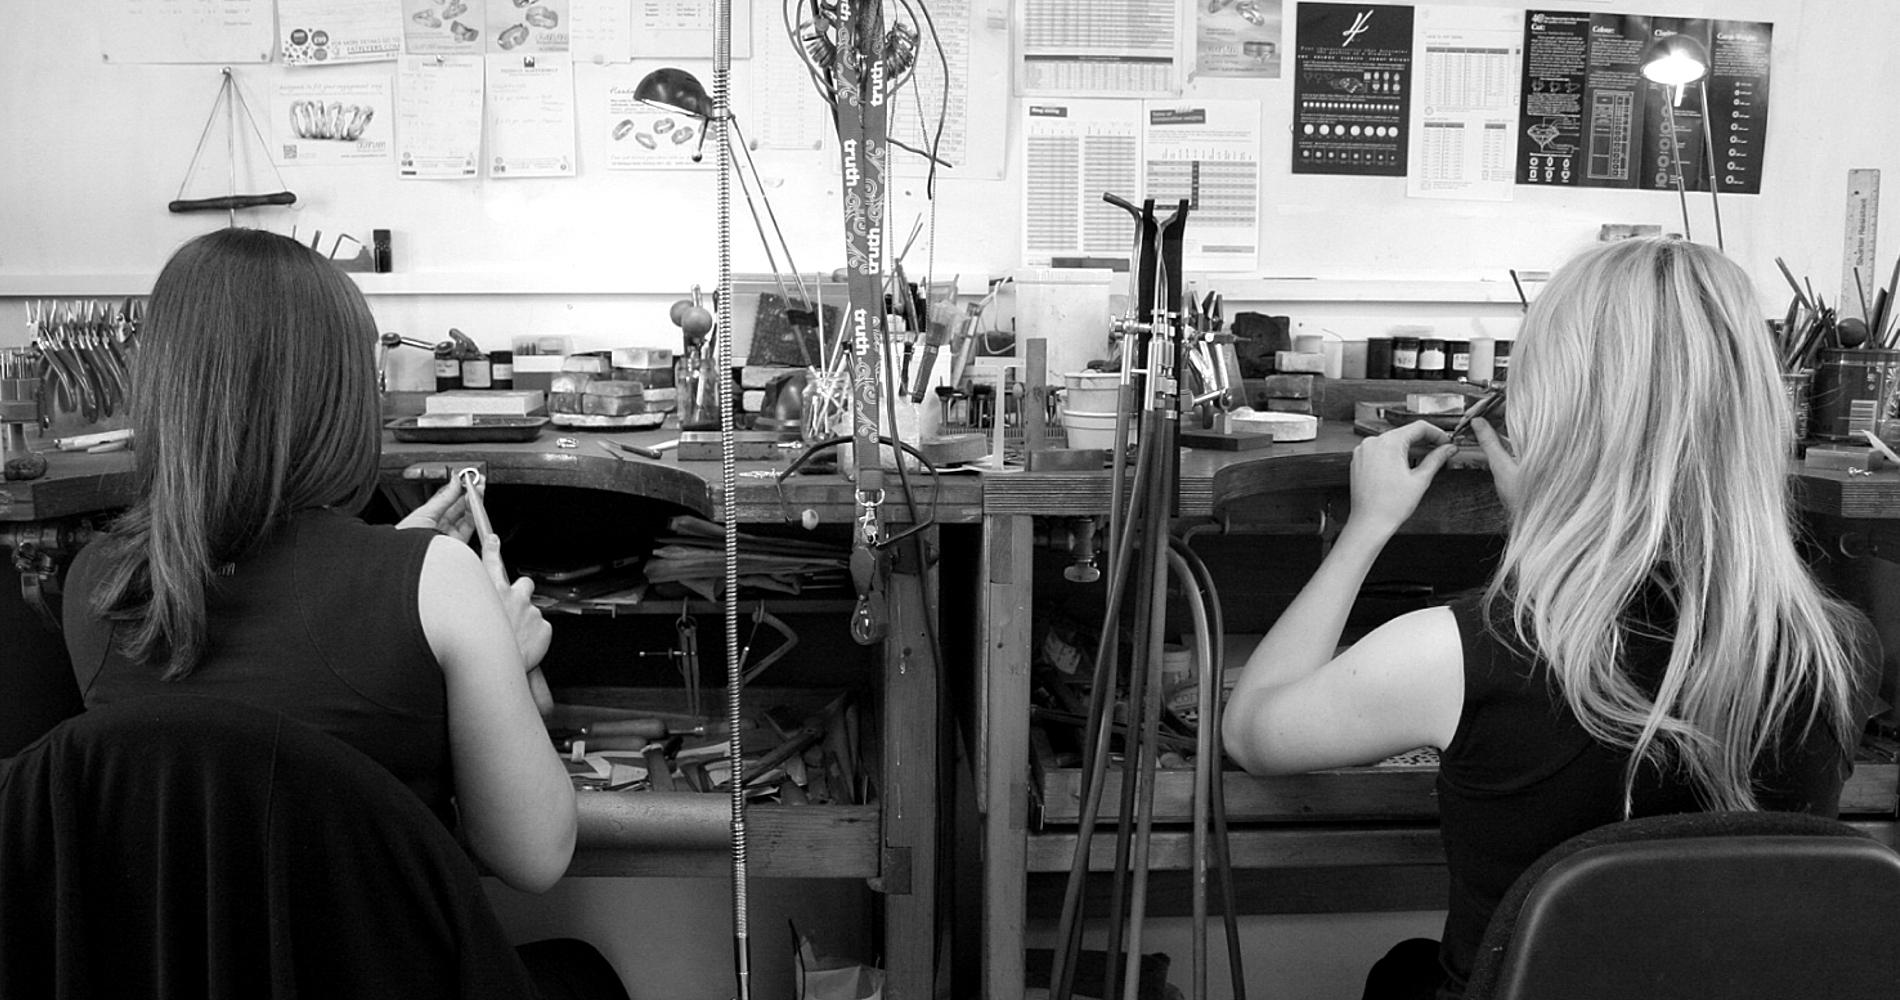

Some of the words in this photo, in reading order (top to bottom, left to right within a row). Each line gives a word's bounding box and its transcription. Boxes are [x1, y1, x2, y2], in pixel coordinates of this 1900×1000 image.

[870, 60, 883, 107] truth
[843, 138, 860, 187] truth
[867, 227, 881, 275] truth
[854, 308, 869, 356] truth
